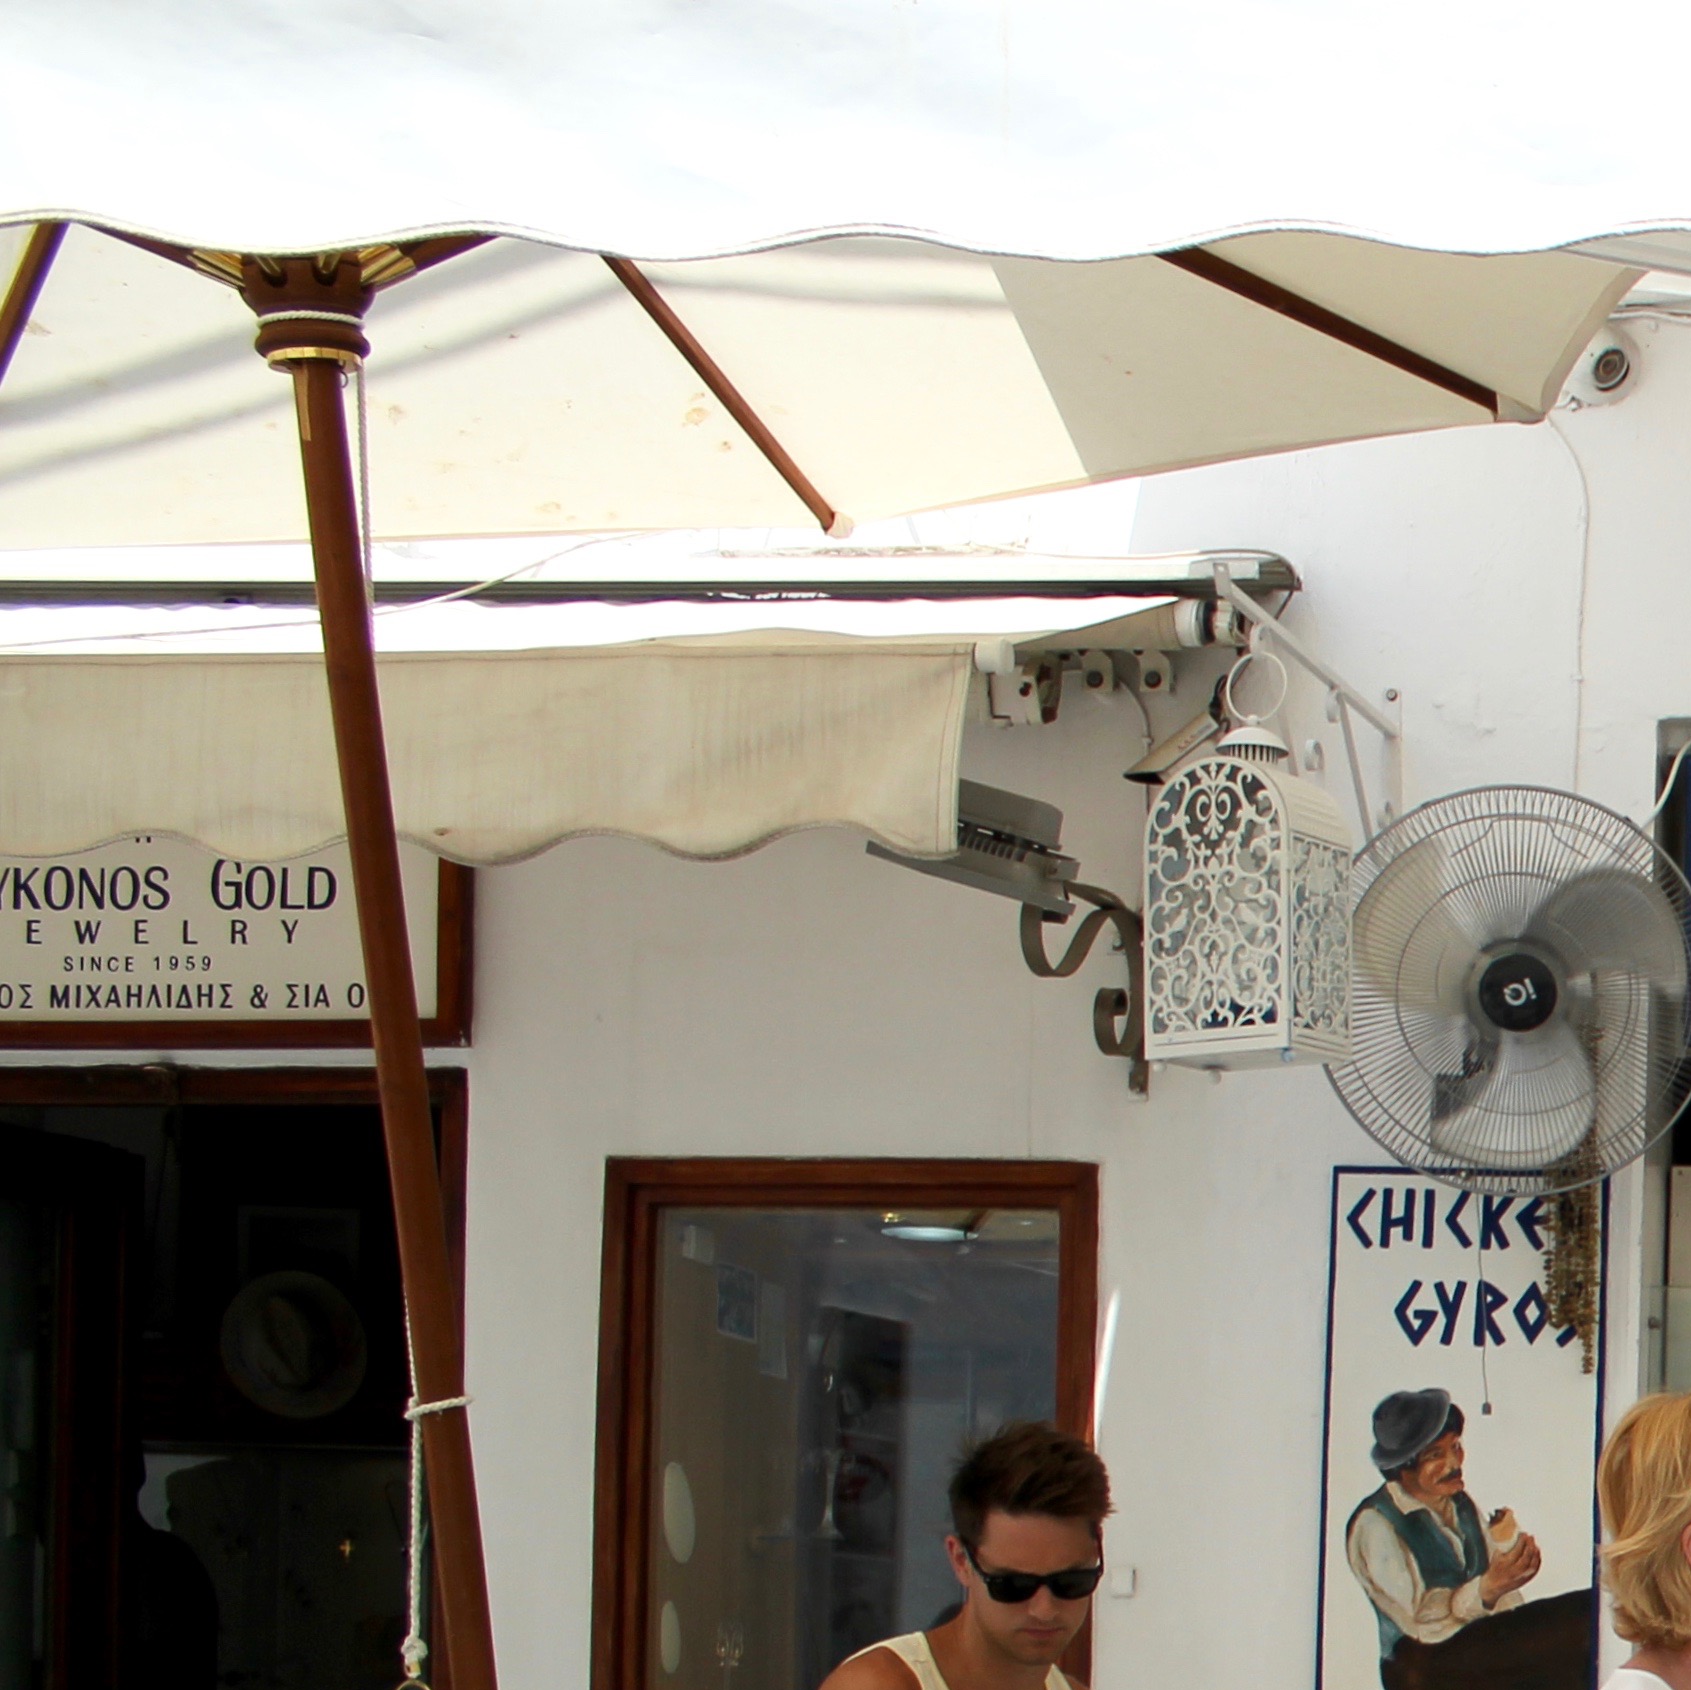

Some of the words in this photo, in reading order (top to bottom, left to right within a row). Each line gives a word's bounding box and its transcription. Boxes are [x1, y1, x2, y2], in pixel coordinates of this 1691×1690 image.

[63, 955, 134, 973] SINCE
[153, 955, 212, 972] 1959
[49, 983, 234, 1009] ΜΙΧΑΗΛΙΔΗΣ
[249, 984, 269, 1009] &
[286, 983, 330, 1009] ΣΙΑ
[1346, 1187, 1549, 1251] CHICKE
[1394, 1279, 1577, 1347] GYRO
